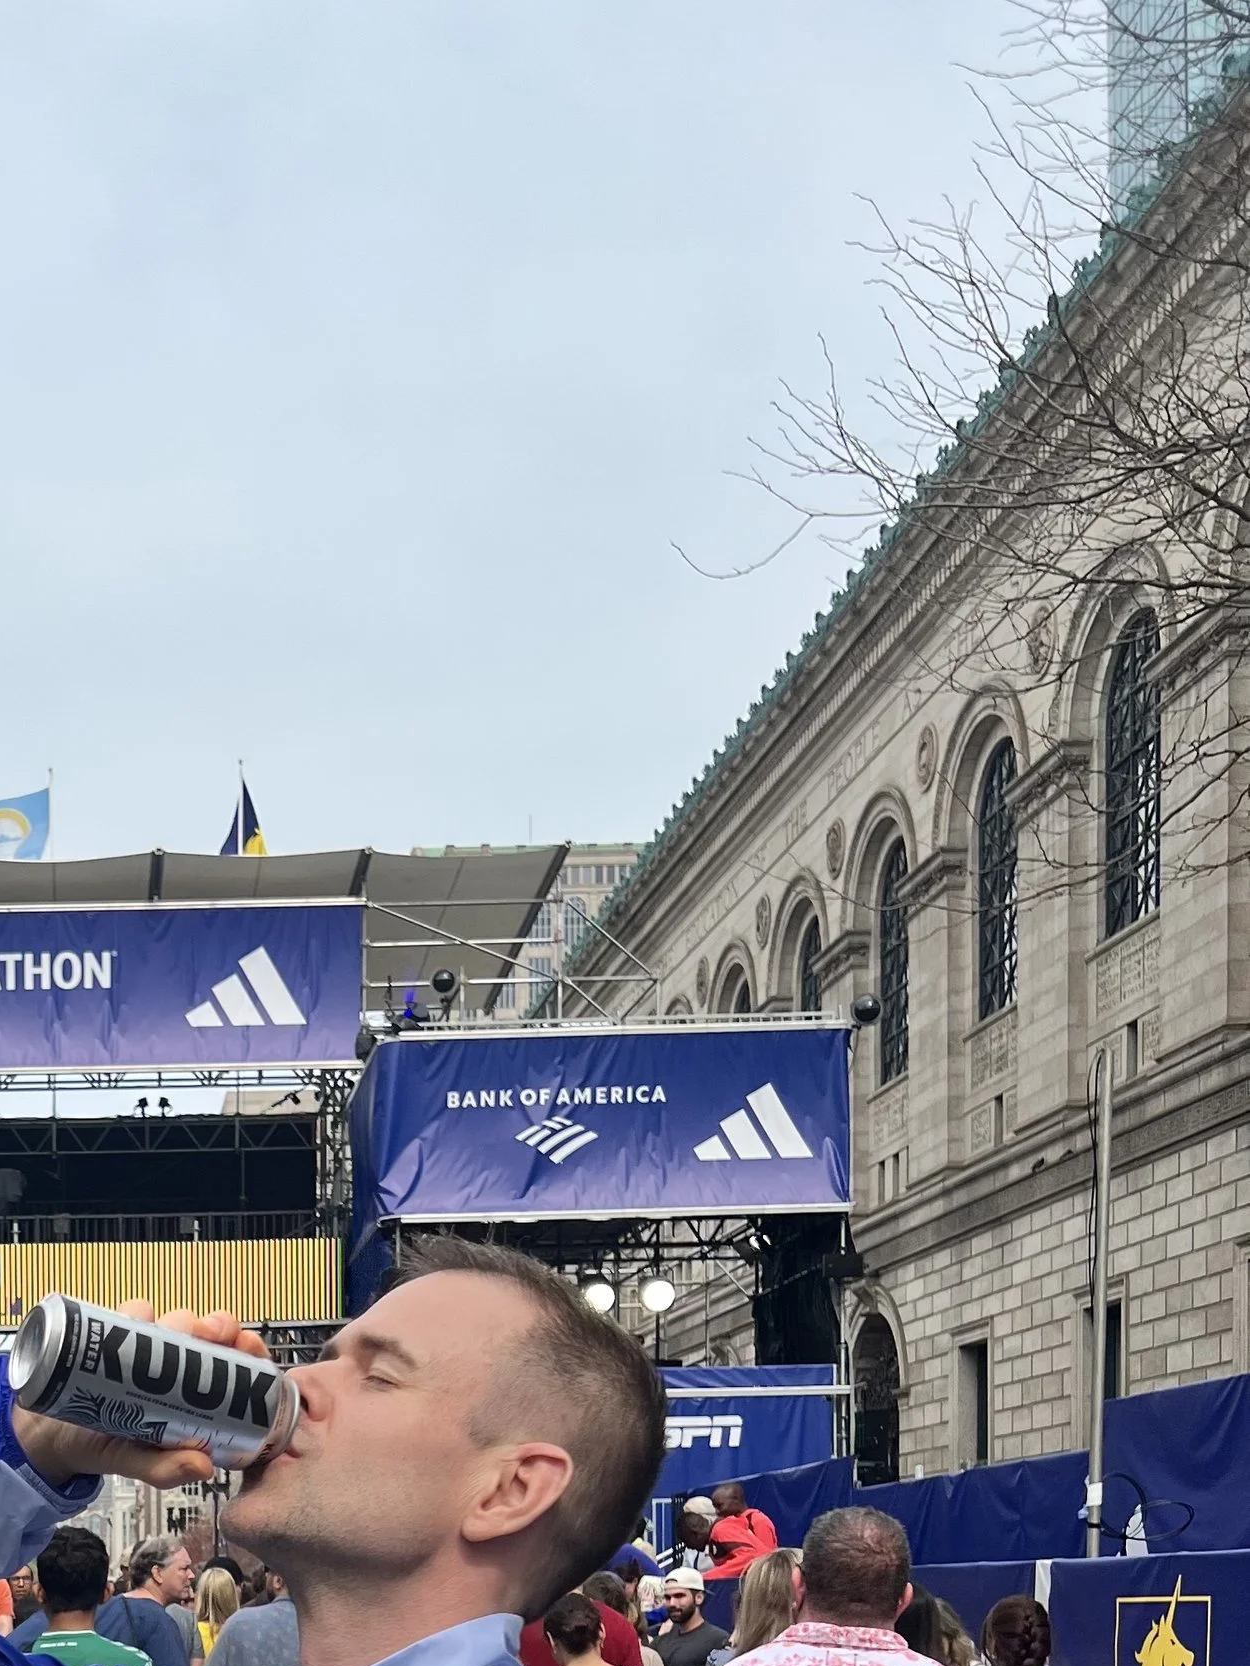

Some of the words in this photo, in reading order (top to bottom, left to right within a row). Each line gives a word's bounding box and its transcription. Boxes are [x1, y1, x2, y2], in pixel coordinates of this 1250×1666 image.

[447, 1089, 514, 1109] BANK
[519, 1087, 551, 1107] OF
[556, 1085, 666, 1106] AMERICA
[84, 1320, 104, 1372] WATER
[102, 1325, 276, 1428] KUUK
[664, 1415, 743, 1449] SPN
